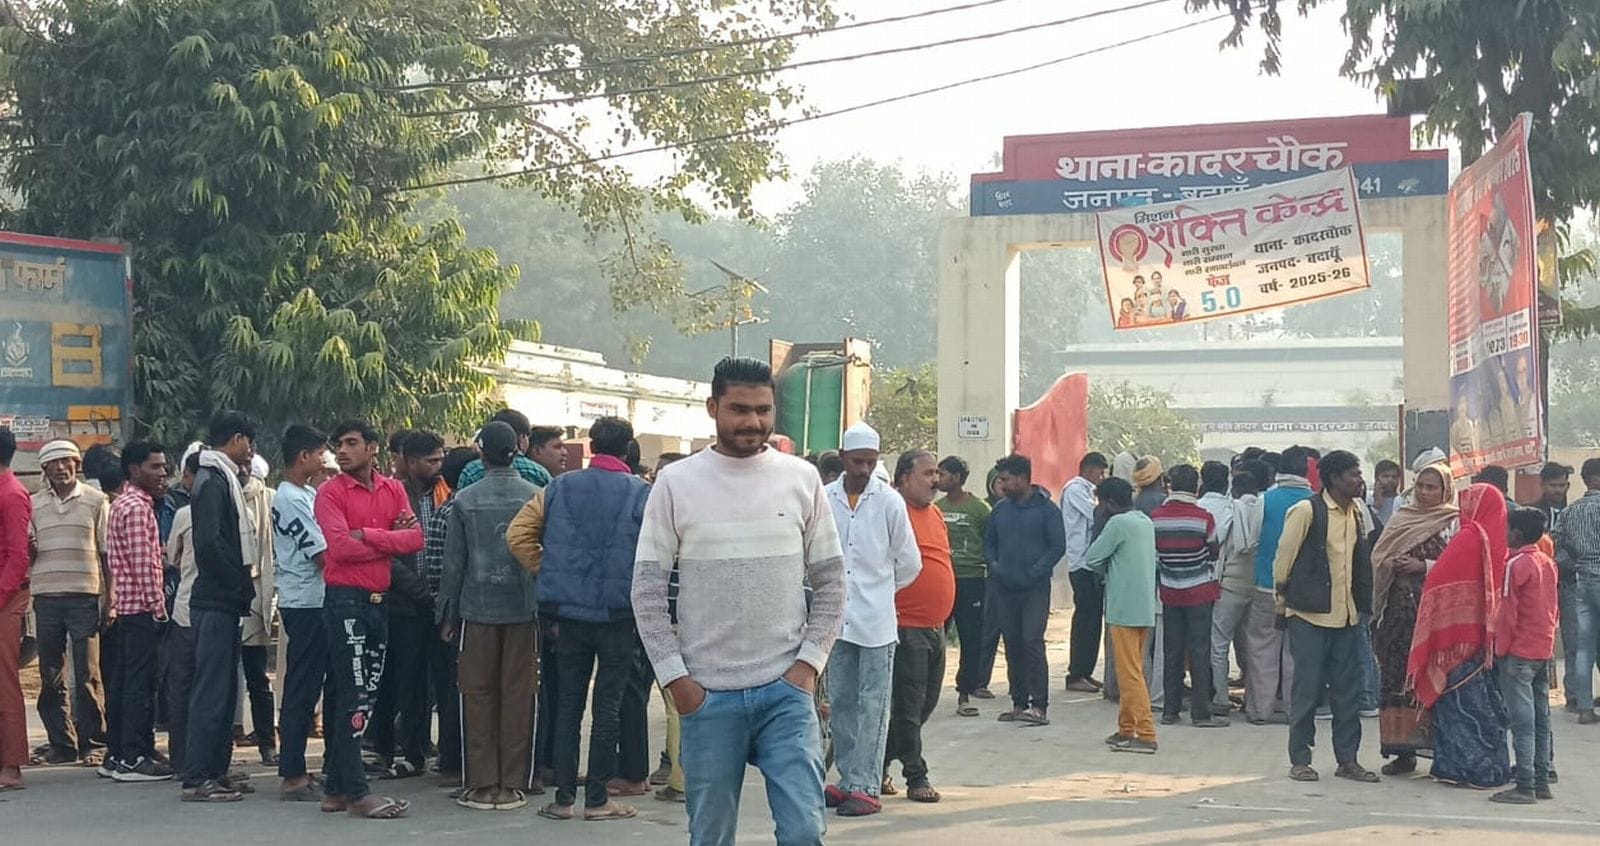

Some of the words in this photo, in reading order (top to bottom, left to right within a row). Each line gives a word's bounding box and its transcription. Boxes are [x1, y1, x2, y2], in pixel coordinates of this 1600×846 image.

[1135, 209, 1174, 224] मिशन
[1149, 204, 1247, 268] शक्ति
[1253, 188, 1349, 224] केन्द्र
[1289, 267, 1351, 289] 2025-26
[1201, 286, 1241, 313] 5.0
[1509, 330, 1529, 349] 1930
